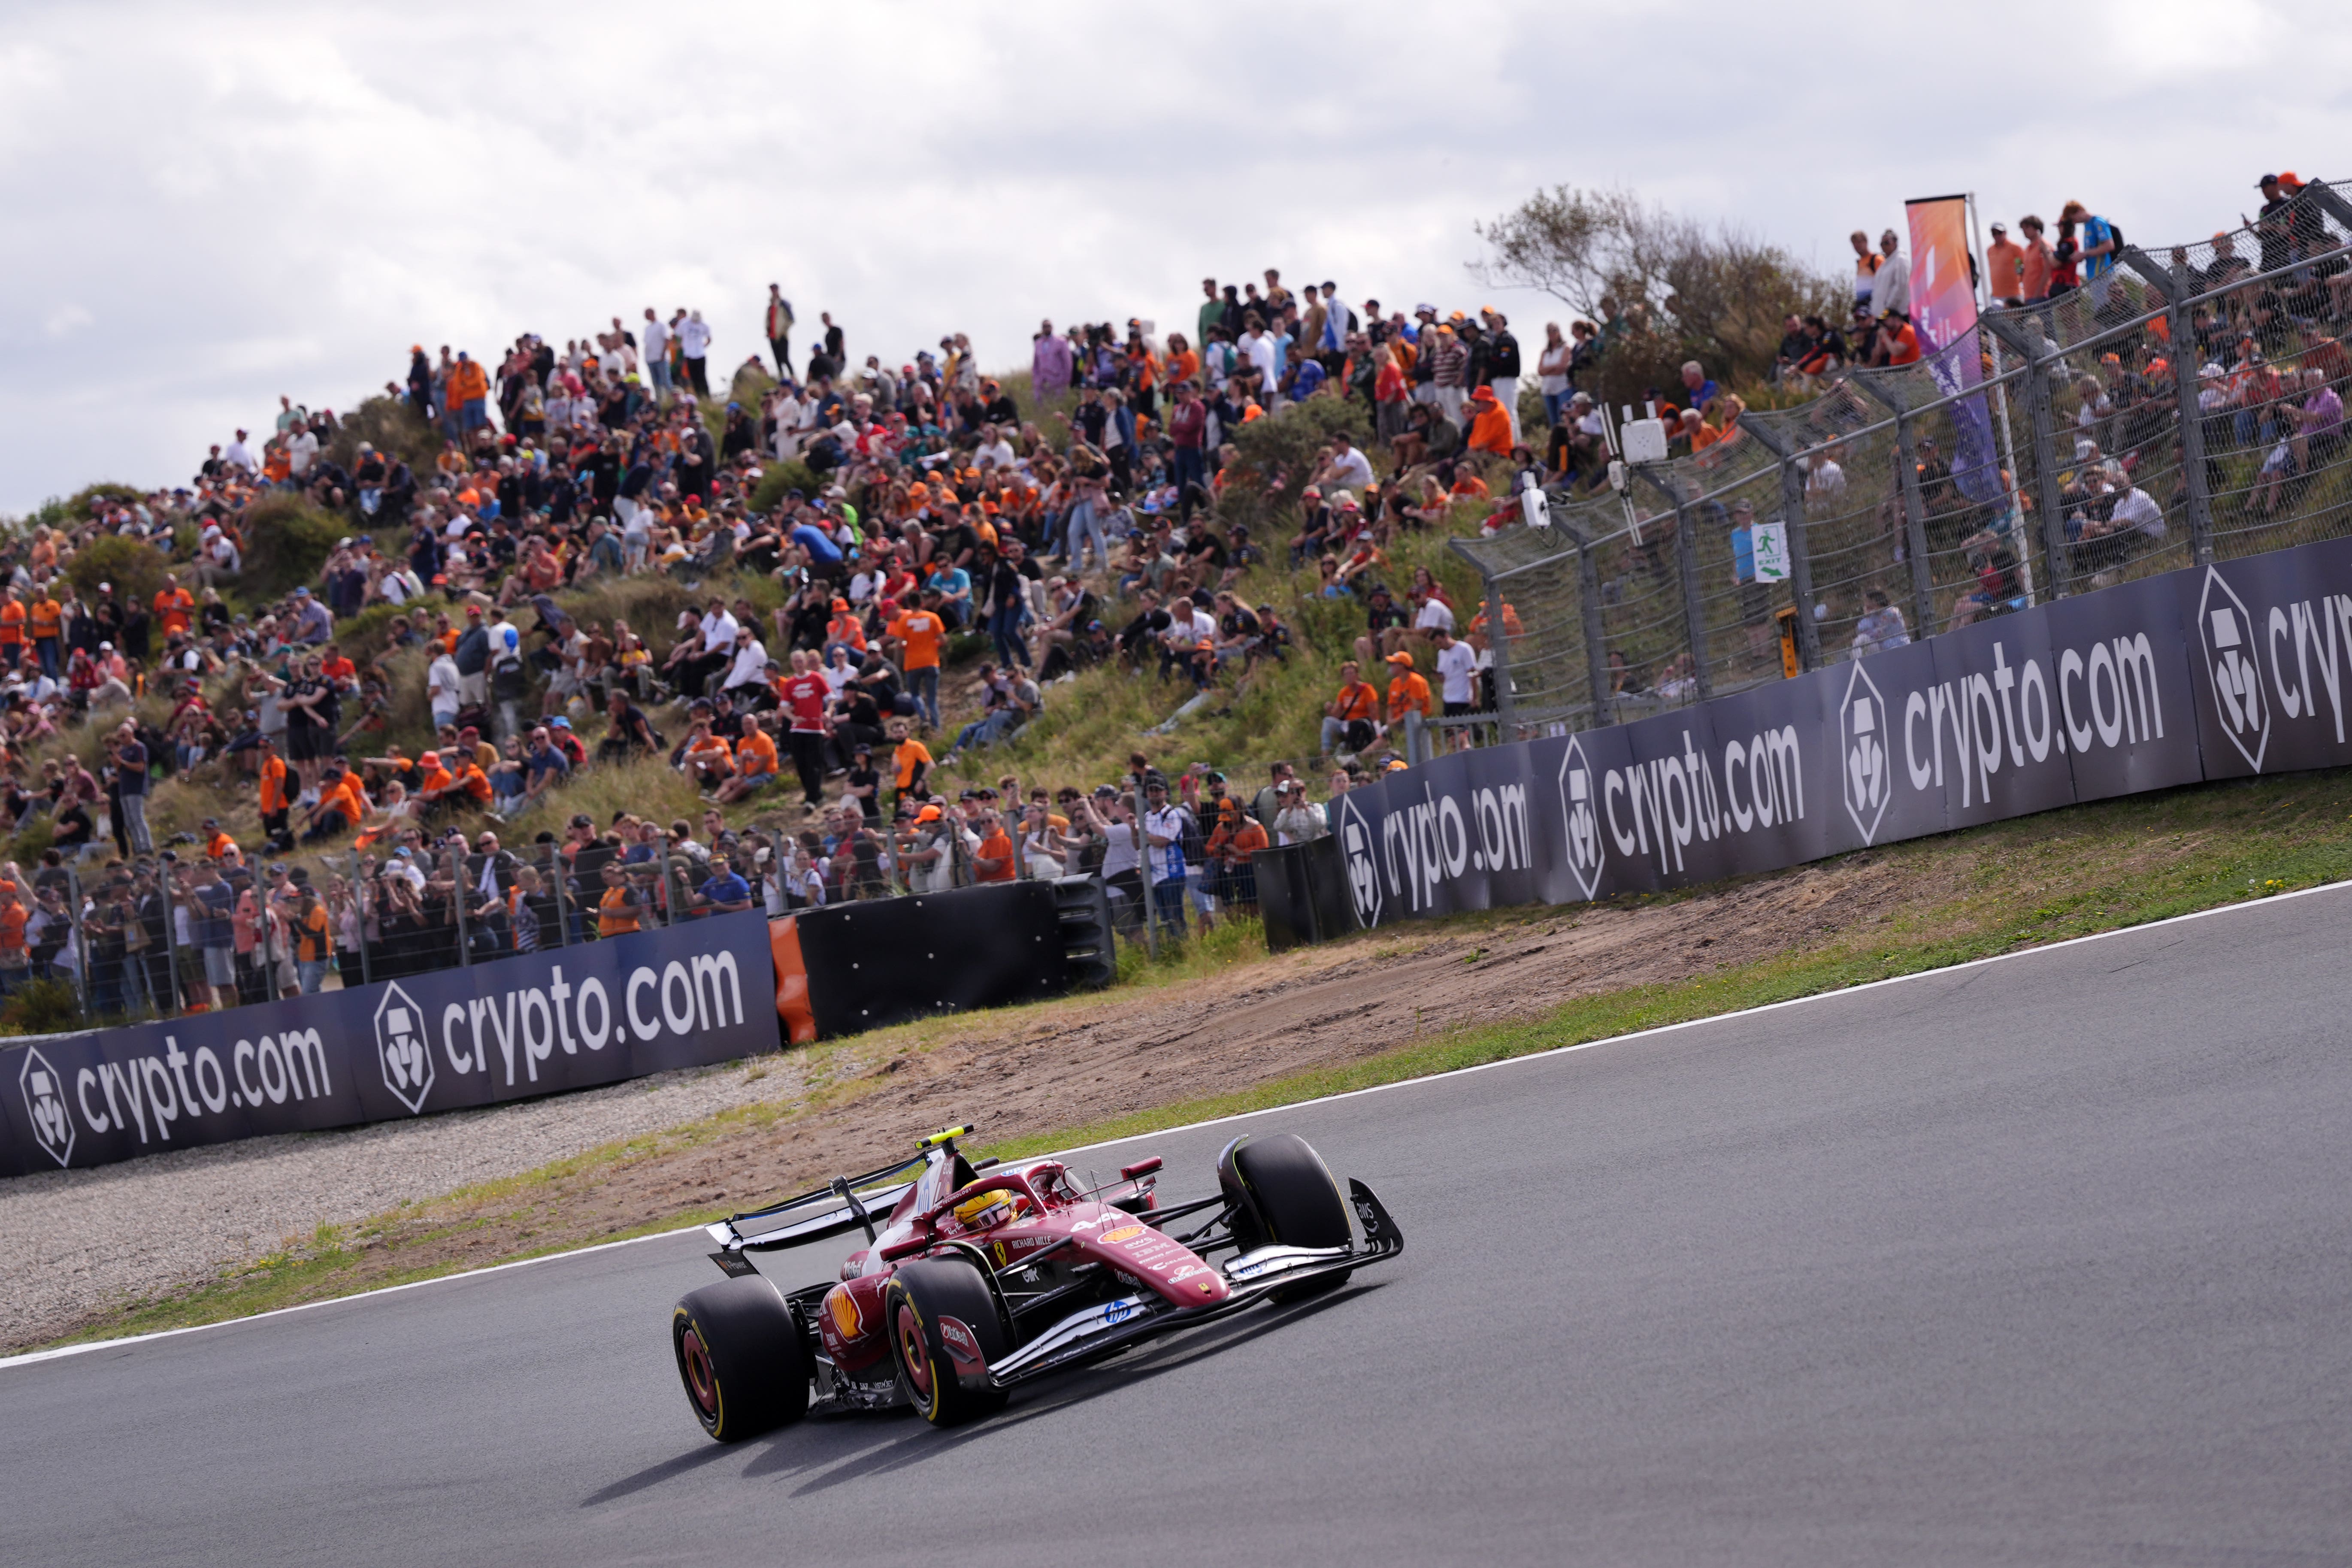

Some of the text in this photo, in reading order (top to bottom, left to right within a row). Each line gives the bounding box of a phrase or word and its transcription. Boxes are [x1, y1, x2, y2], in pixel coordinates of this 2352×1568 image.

[1904, 632, 2163, 808] crypto.com
[1604, 725, 1804, 875] crypto.com
[443, 950, 744, 1087] crypto.com
[77, 1027, 332, 1144] crypto.com
[942, 1162, 953, 1174] ZCG
[943, 1187, 972, 1205] TECHNOLOGY
[1357, 1203, 1374, 1219] aws
[944, 1222, 964, 1235] Ray-Ban
[1070, 1212, 1124, 1233] 44
[1011, 1235, 1052, 1250] RICHARD MILLE
[1124, 1236, 1153, 1248] aws
[1132, 1242, 1171, 1258] IBM
[1108, 1302, 1129, 1323] hp
